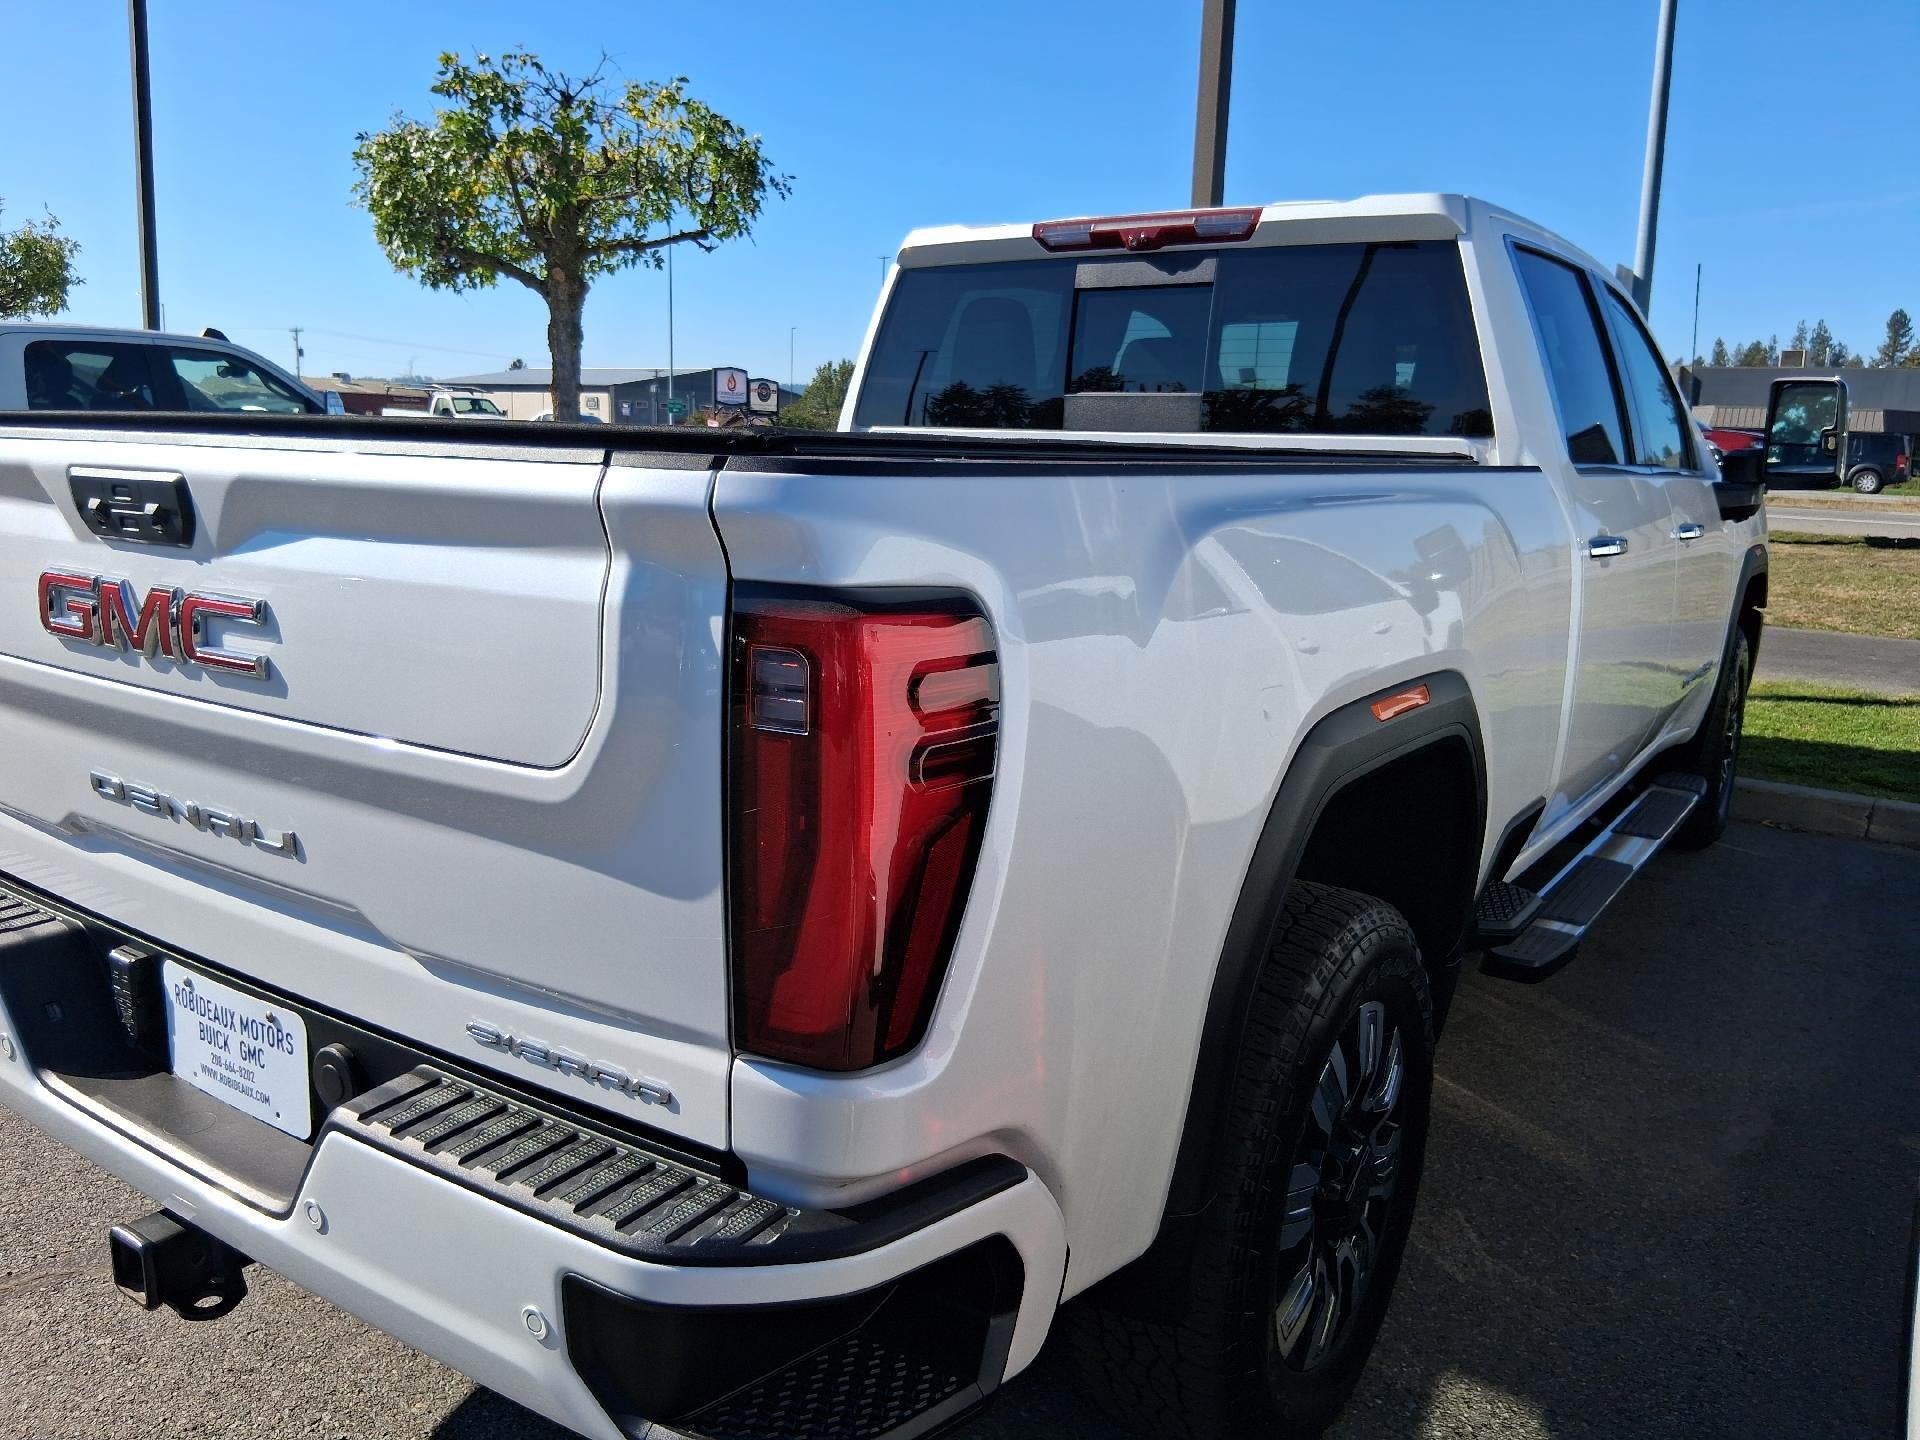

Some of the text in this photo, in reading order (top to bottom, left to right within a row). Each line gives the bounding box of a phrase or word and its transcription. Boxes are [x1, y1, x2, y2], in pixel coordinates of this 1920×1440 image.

[38, 567, 270, 681] GMC
[90, 770, 299, 859] DENALI
[174, 984, 294, 1055] ROBIDEAUX MOTORS
[199, 1022, 266, 1069] BUICK GMC
[201, 1063, 271, 1107] WWW.ROBIDEAUX.COM
[466, 1020, 673, 1105] SIERRA
